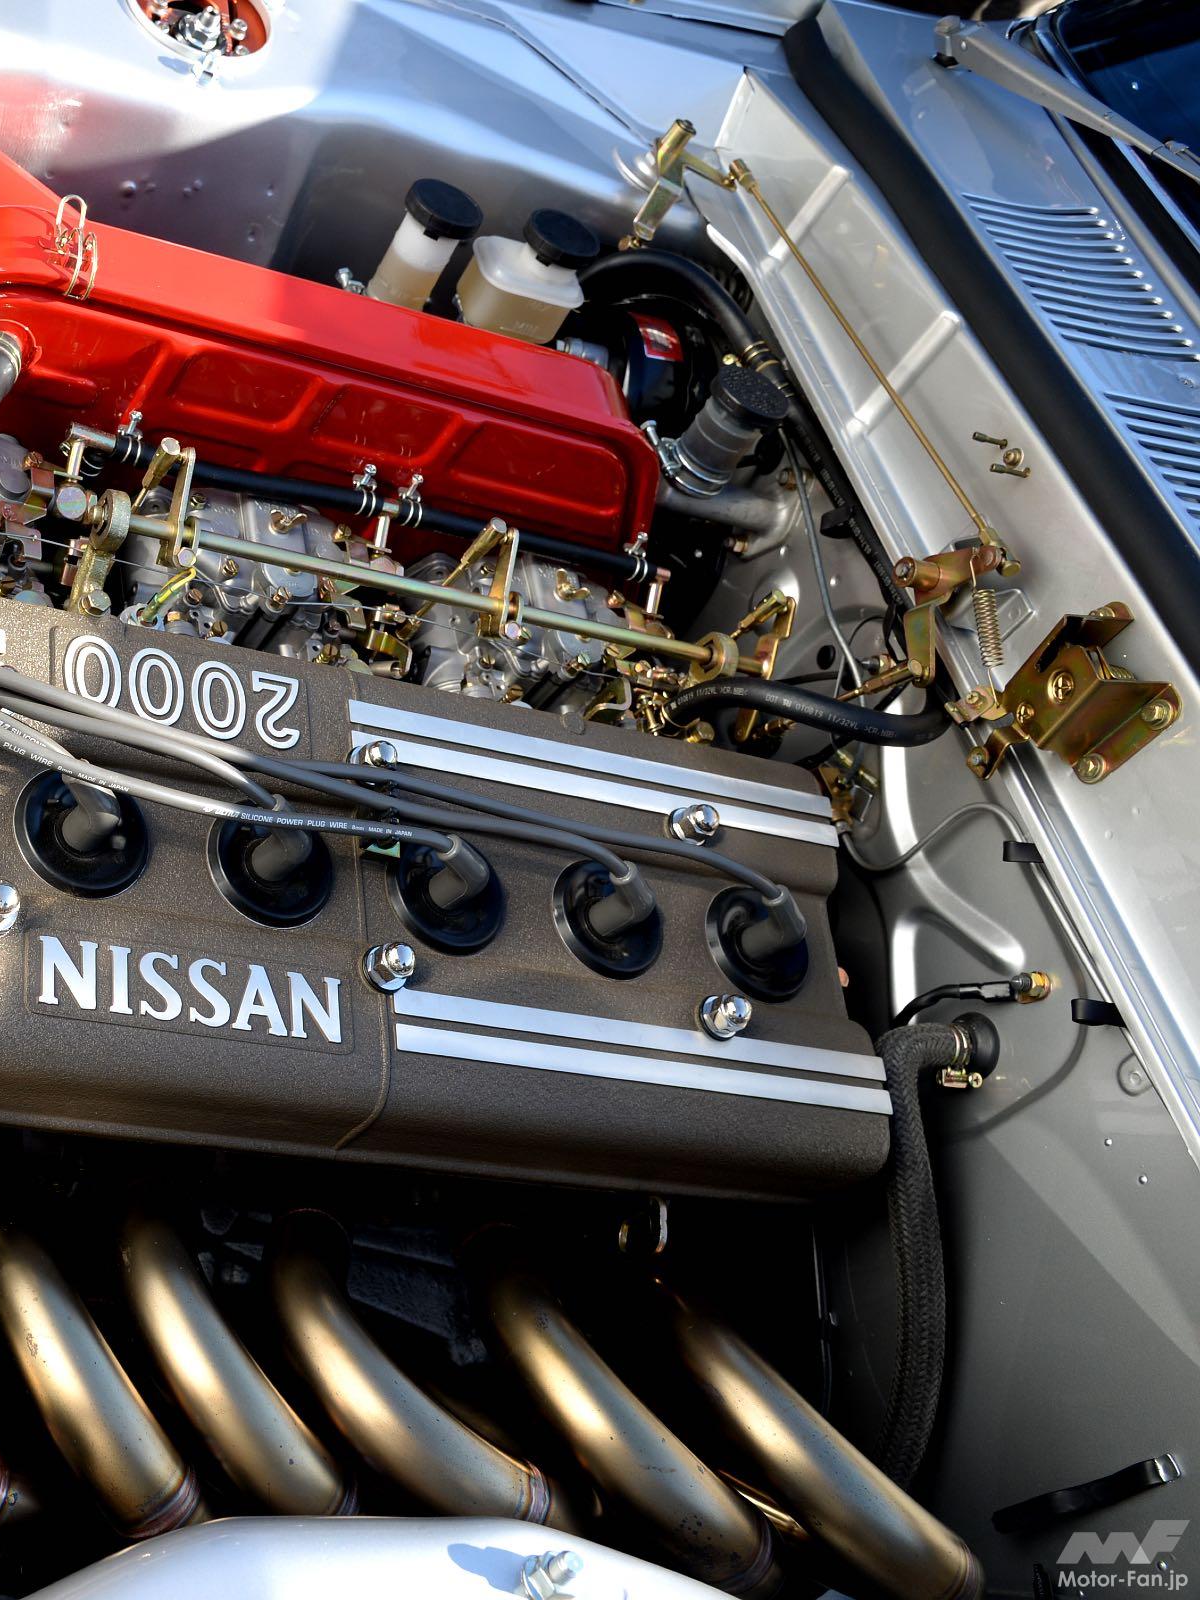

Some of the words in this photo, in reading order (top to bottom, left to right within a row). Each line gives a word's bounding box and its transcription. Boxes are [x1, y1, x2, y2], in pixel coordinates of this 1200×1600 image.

[64, 635, 300, 750] 2000
[2, 741, 26, 756] PLUG
[29, 753, 53, 767] WIRE
[78, 772, 96, 785] MADE
[108, 781, 130, 792] JAPAN
[241, 812, 273, 824] SILICONE
[276, 816, 303, 826] POWER
[307, 820, 326, 828] PLUG
[329, 821, 347, 830] WIRE
[368, 826, 384, 834] MADE
[394, 829, 412, 837] JAPAN
[37, 934, 341, 1044] NISSAN
